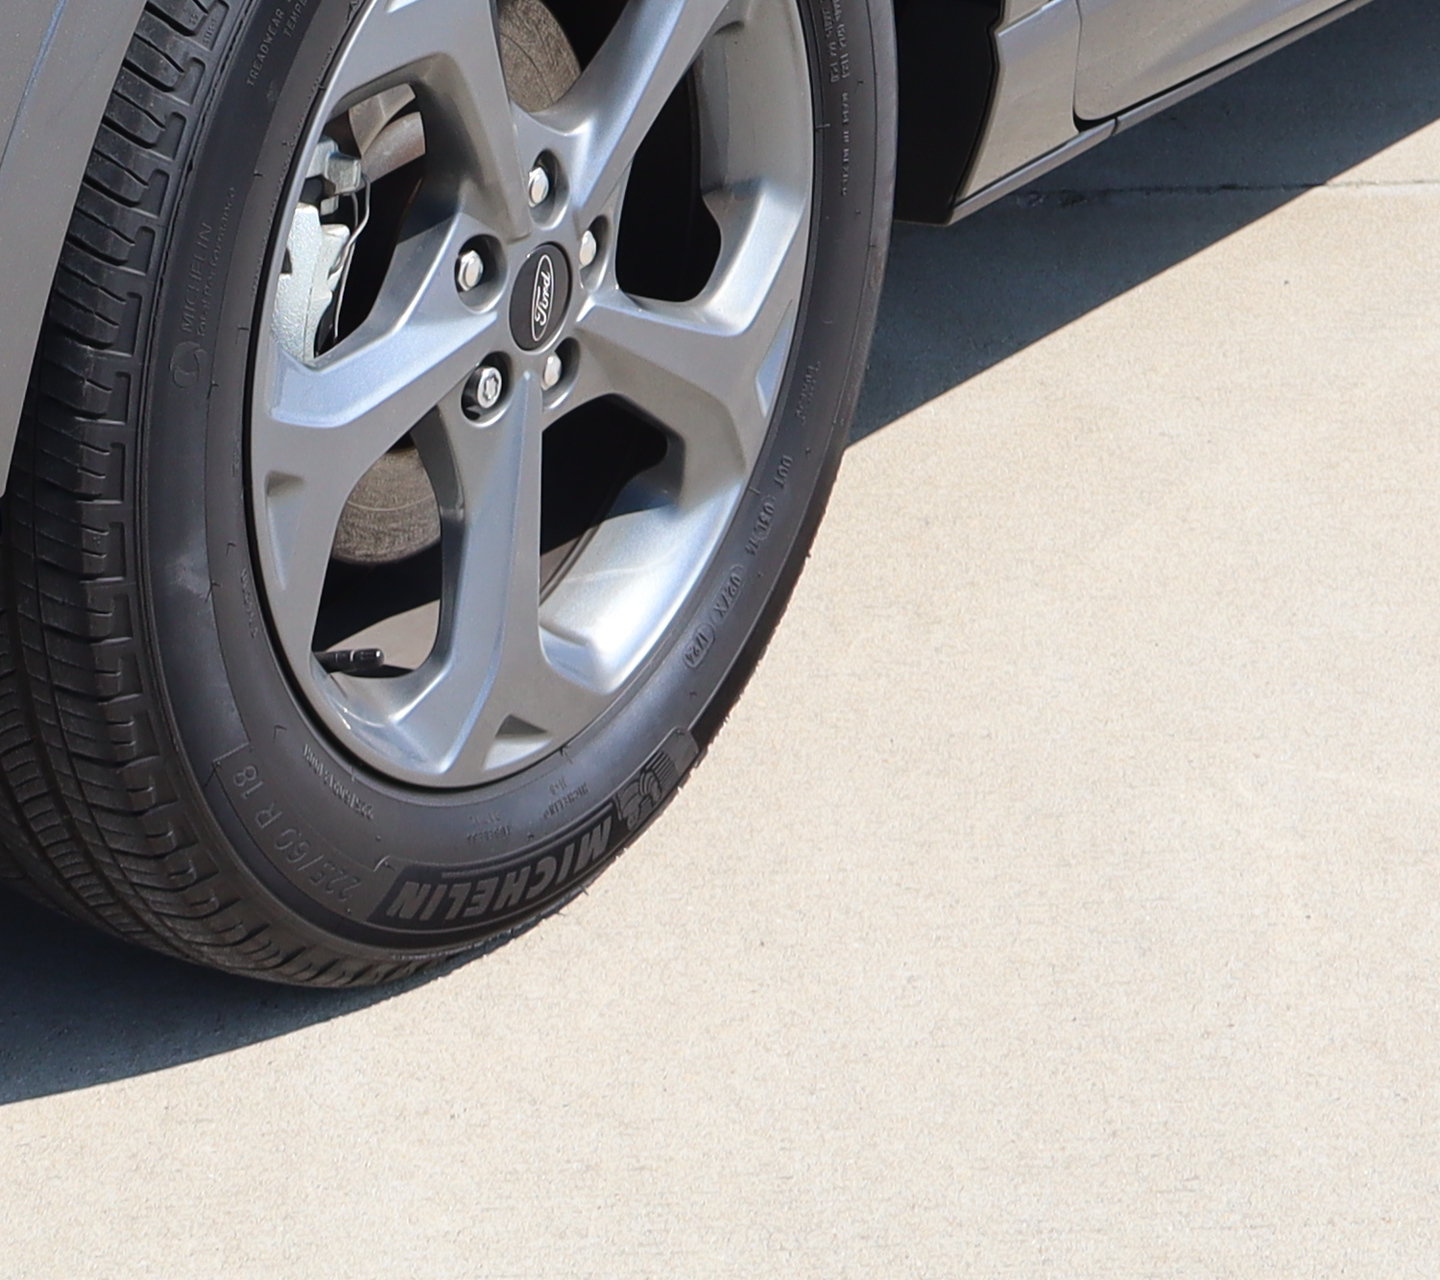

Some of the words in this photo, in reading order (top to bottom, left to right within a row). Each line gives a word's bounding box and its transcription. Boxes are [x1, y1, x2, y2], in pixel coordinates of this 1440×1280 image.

[180, 221, 214, 334] MICHELIN
[533, 269, 553, 328] Ford
[232, 764, 266, 801] 18
[254, 802, 284, 830] R
[273, 827, 362, 903] 225/60
[385, 814, 614, 921] MICHELIN
